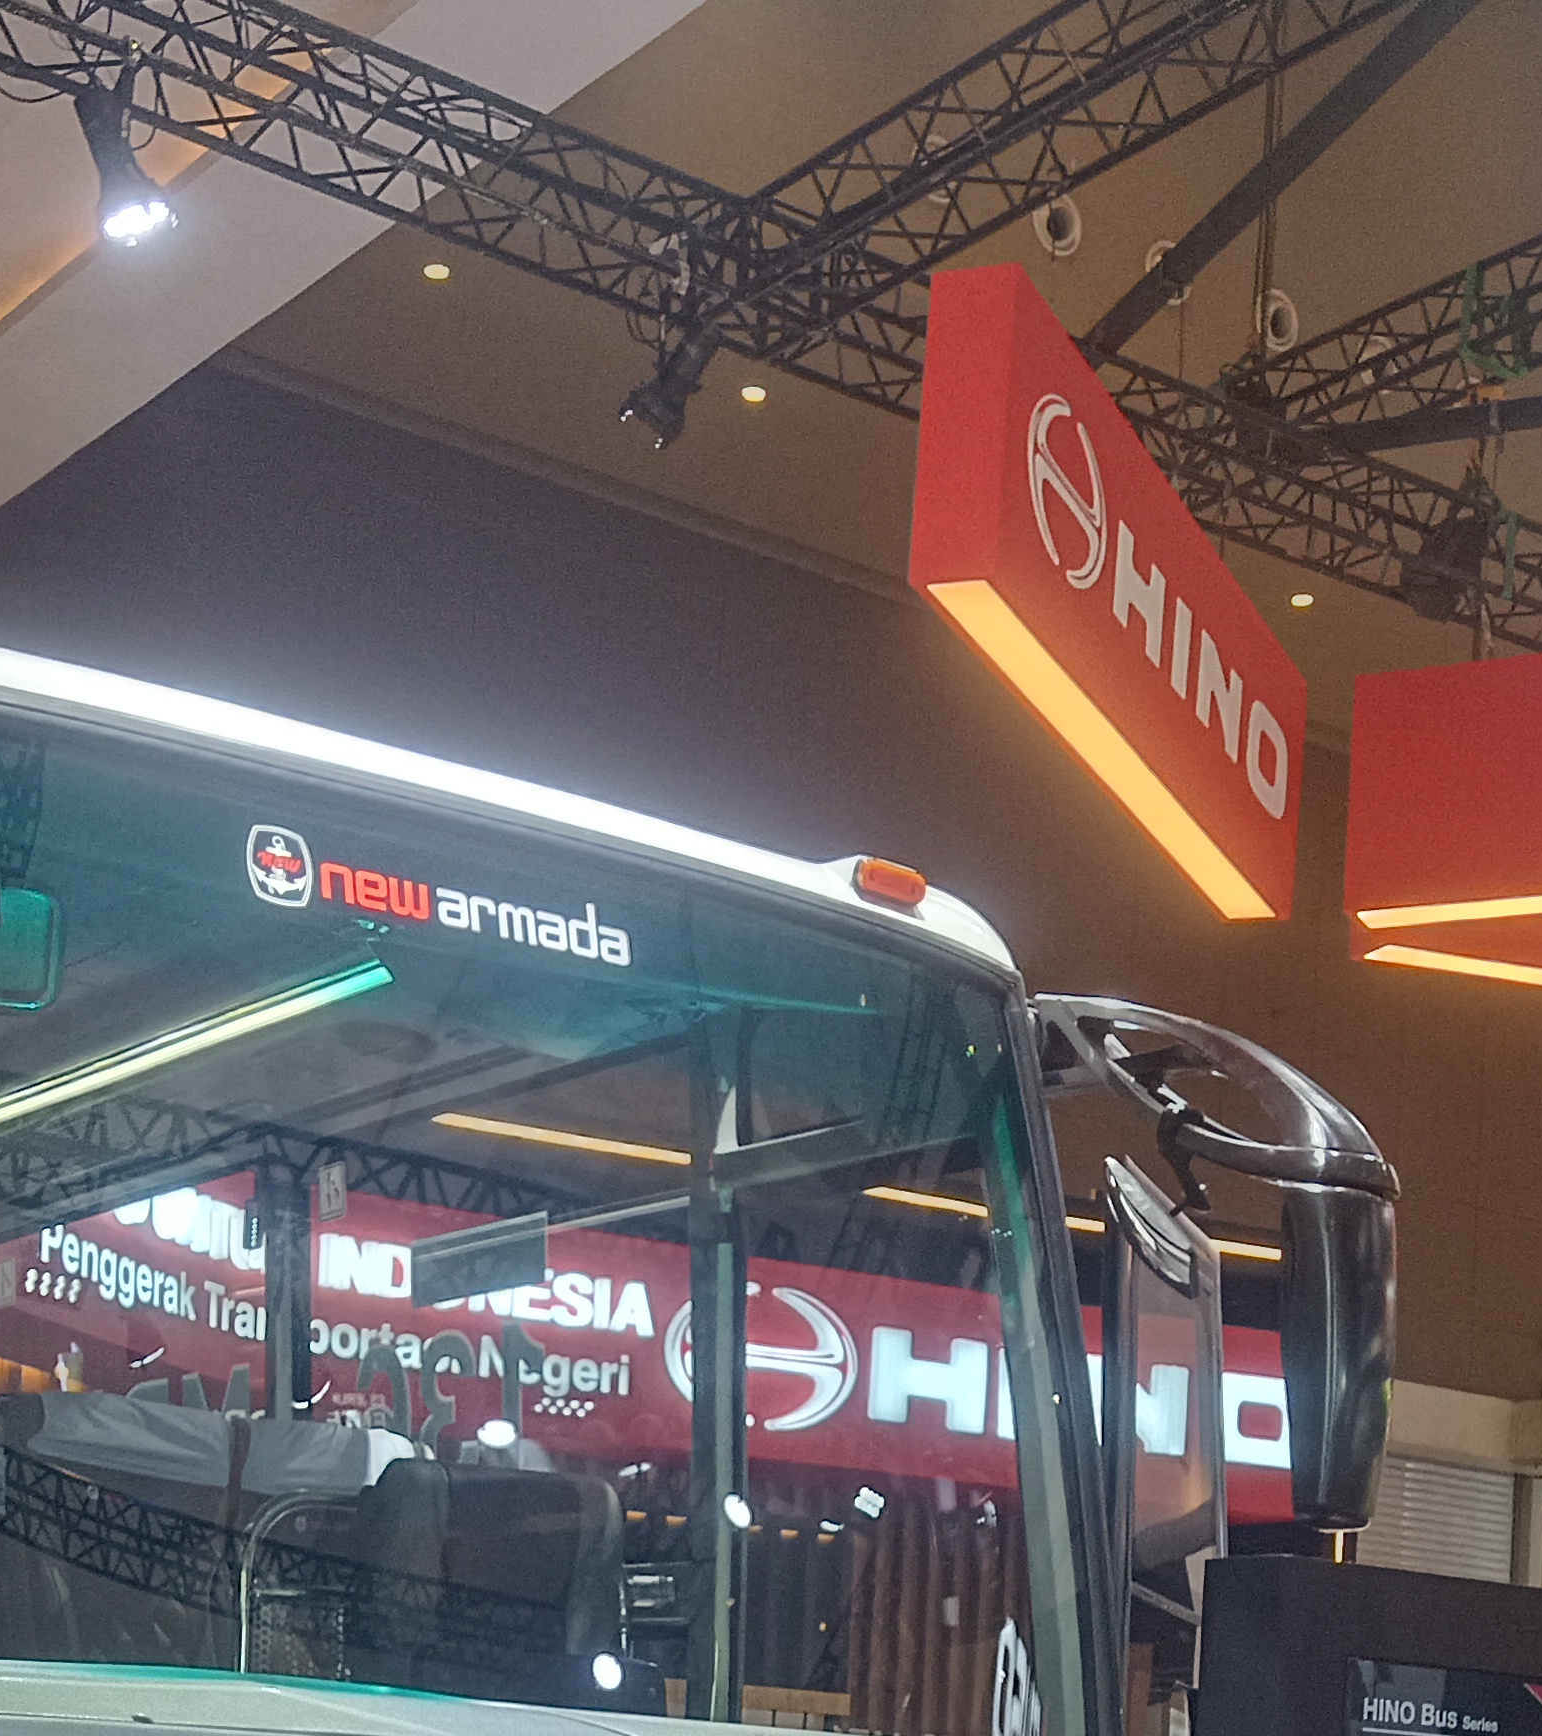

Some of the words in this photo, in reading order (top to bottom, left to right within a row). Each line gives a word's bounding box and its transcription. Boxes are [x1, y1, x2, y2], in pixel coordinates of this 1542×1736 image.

[1112, 519, 1288, 819] HINO
[319, 860, 430, 920] new
[436, 886, 632, 967] armada
[1362, 1697, 1416, 1725] HINO
[1421, 1703, 1459, 1730] Bus
[1462, 1716, 1499, 1734] Series
